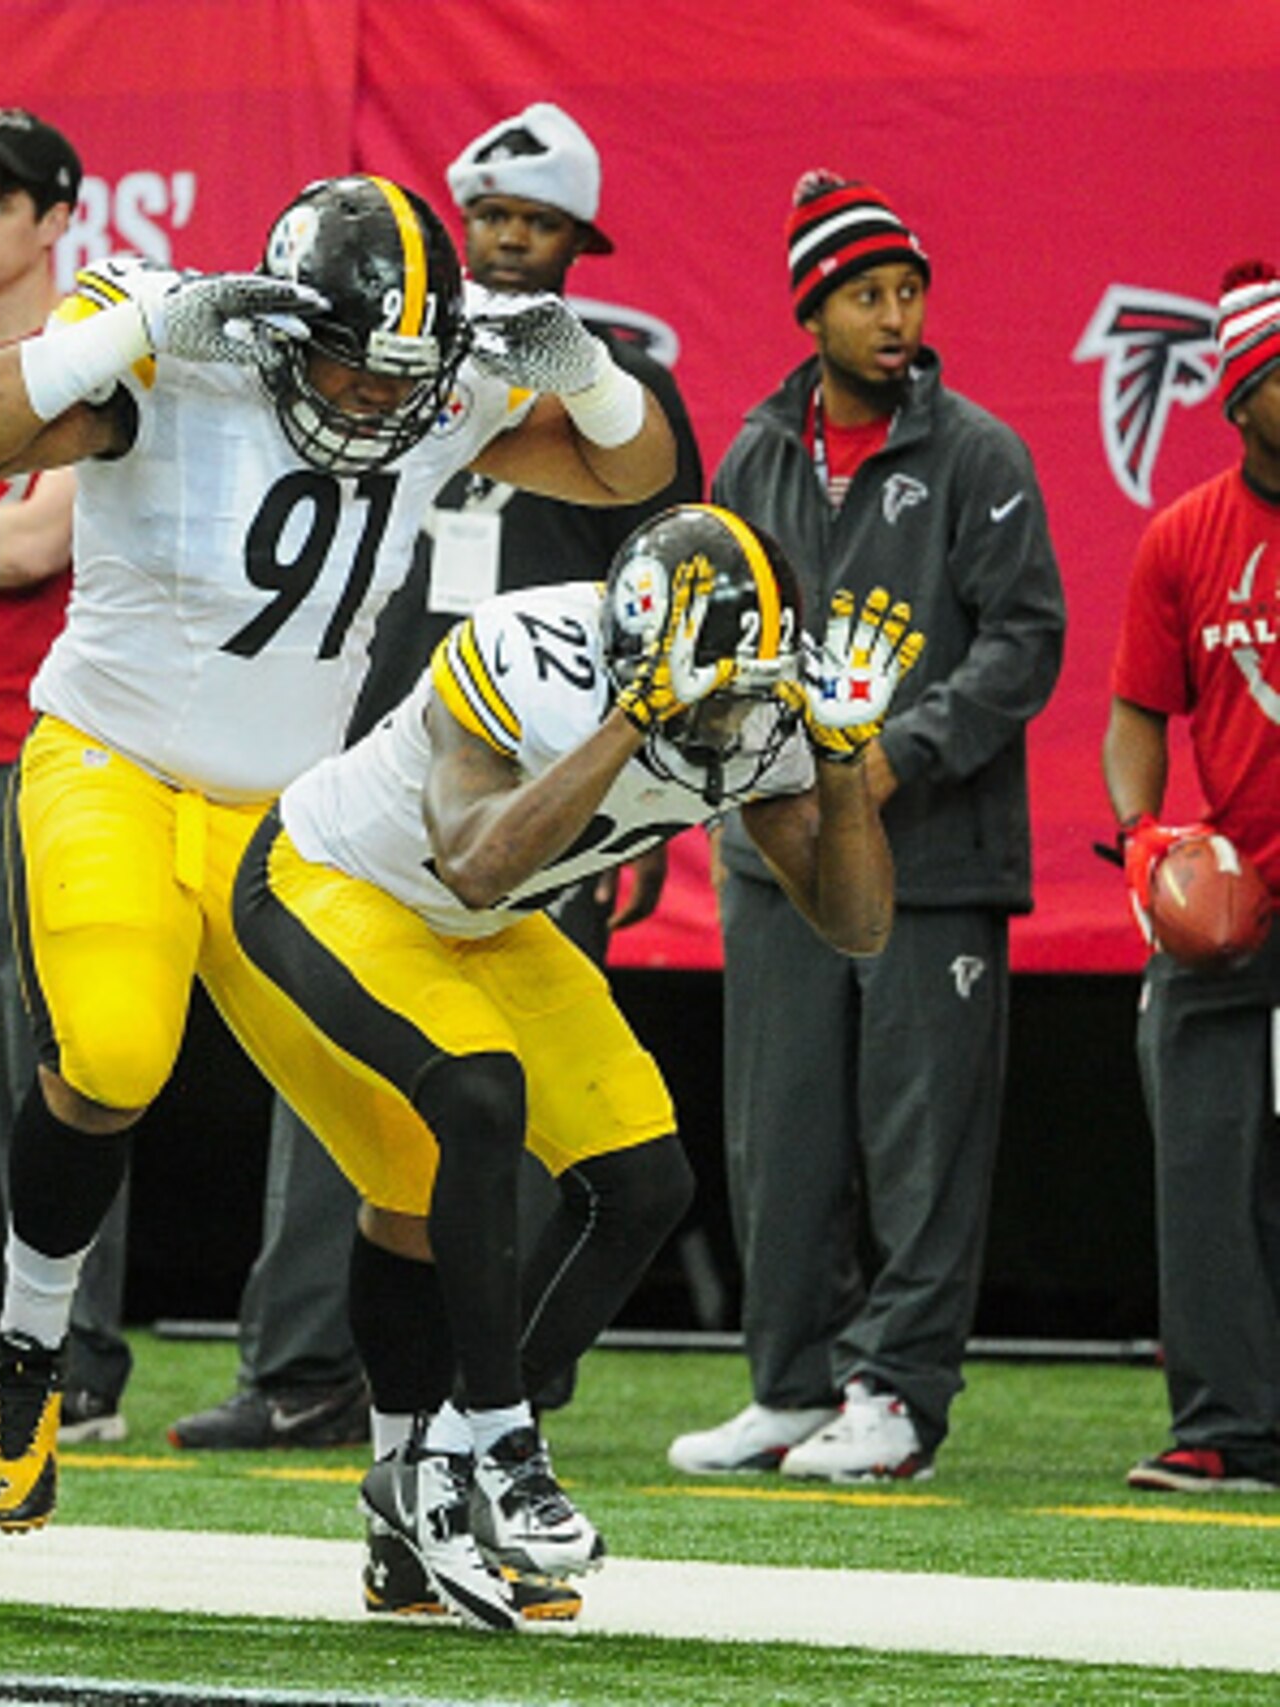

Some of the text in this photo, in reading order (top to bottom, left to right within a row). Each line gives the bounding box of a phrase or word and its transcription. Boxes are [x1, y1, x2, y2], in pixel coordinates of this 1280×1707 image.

[218, 469, 402, 660] 91
[515, 611, 597, 691] 22
[739, 606, 795, 653] 22
